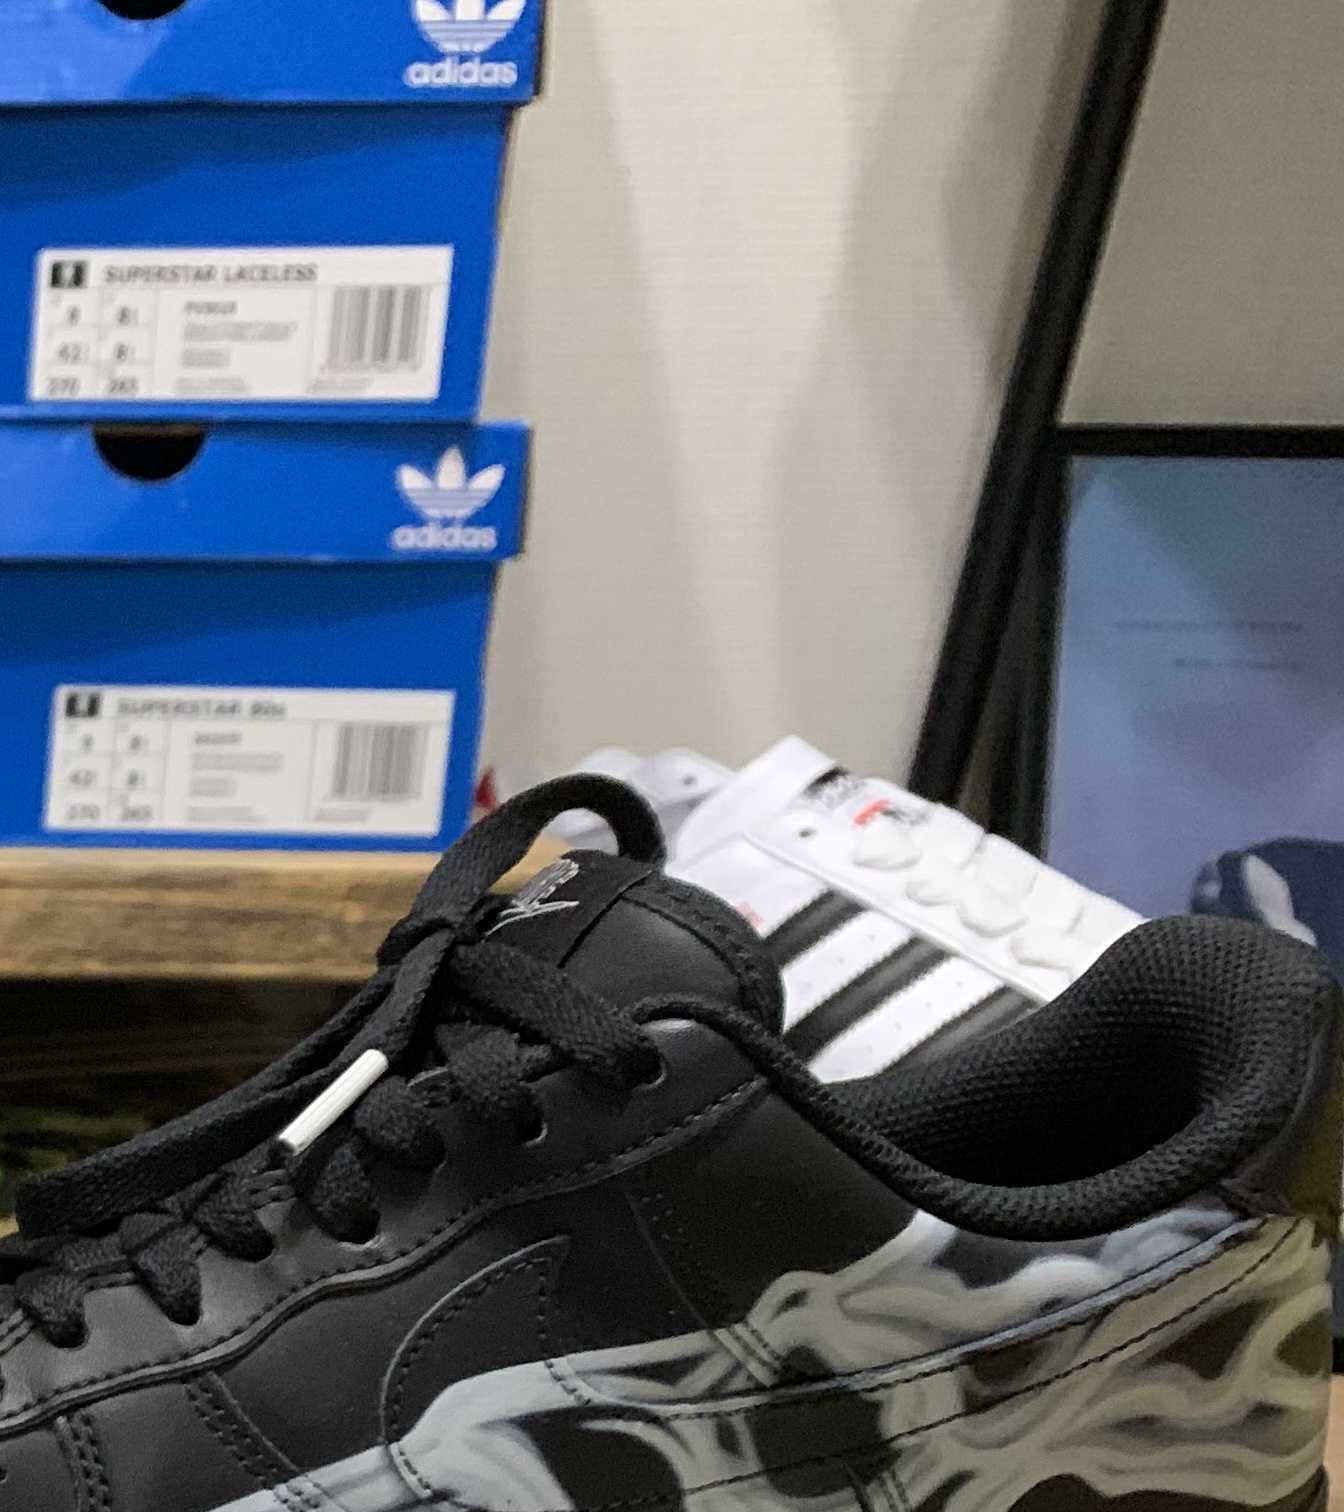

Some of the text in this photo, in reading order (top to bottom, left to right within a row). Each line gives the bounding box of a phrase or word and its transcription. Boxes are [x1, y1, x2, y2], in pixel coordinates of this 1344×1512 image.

[403, 56, 518, 87] adidas
[104, 263, 318, 283] SUPERSTAR LACELESS
[389, 522, 497, 551] adidas
